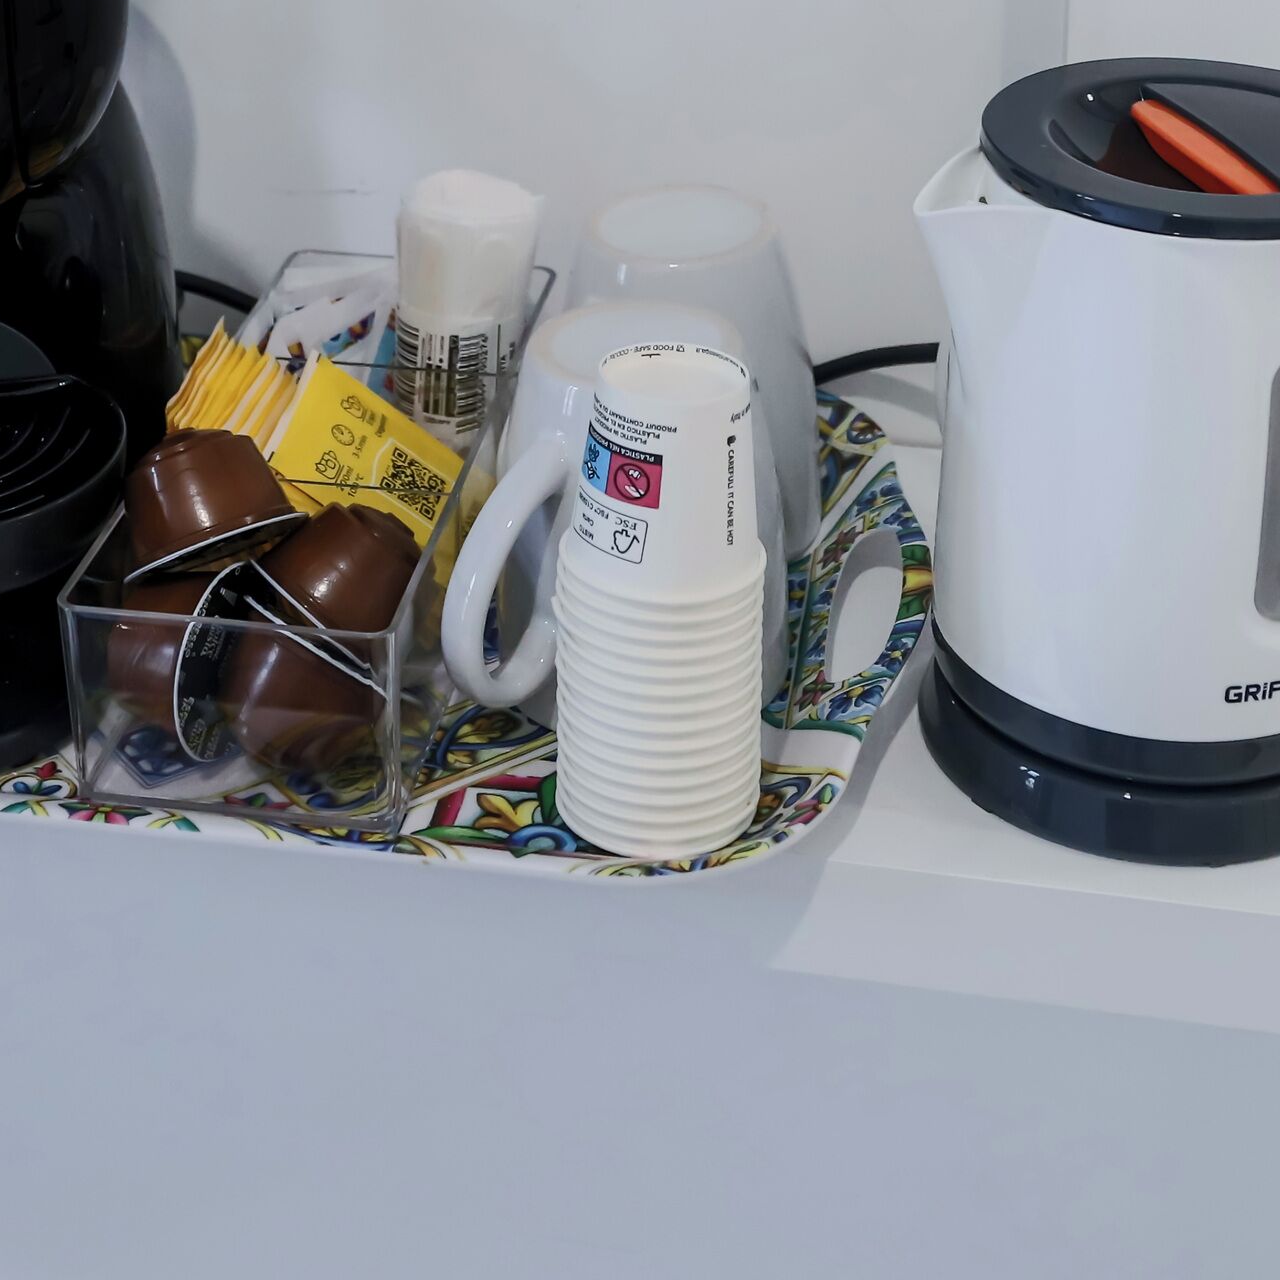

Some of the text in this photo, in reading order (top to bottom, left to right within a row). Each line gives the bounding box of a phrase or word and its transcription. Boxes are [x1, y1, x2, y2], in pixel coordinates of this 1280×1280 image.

[645, 423, 677, 433] PRODUIT
[620, 433, 647, 445] PLASTIC
[621, 448, 655, 462] PLASTICA
[727, 500, 735, 518] CAN
[615, 516, 637, 531] FSC
